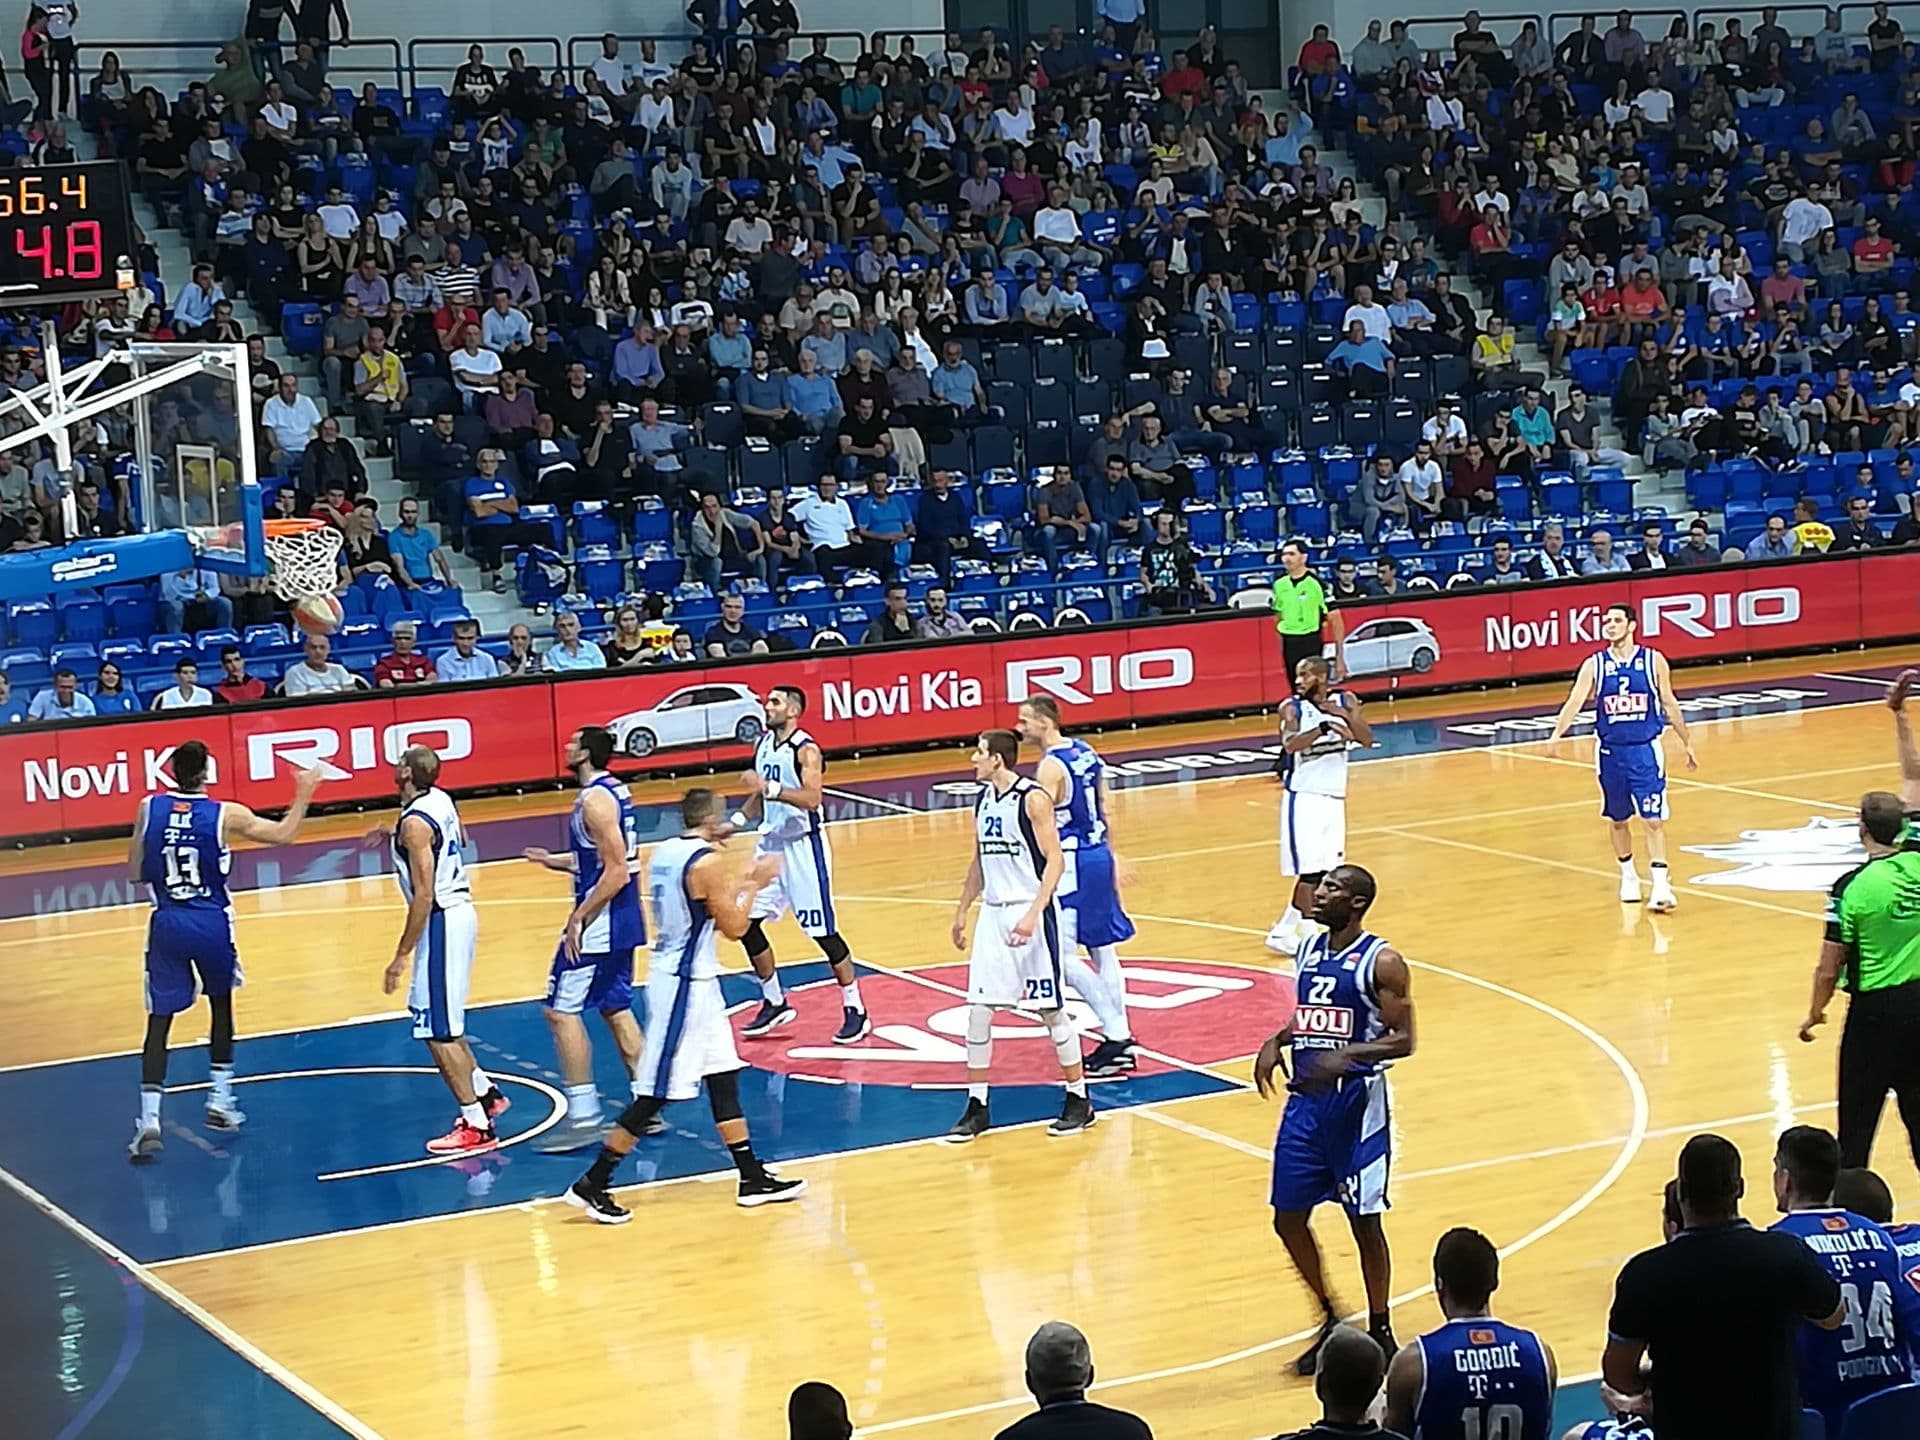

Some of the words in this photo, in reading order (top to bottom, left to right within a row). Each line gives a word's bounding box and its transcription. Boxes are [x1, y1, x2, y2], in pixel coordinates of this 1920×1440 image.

[16, 220, 102, 279] 4.8
[1641, 587, 1801, 638] RIO
[1485, 611, 1559, 652] Novi
[1006, 648, 1195, 705] RIO
[1619, 676, 1631, 696] 2
[822, 675, 910, 721] Novi
[921, 670, 983, 711] Kia
[248, 717, 473, 781] RIO
[23, 751, 130, 803] Novi
[763, 764, 781, 782] 20
[984, 816, 1003, 838] 29
[161, 845, 201, 886] 13
[798, 909, 823, 929] 20
[1025, 978, 1054, 1000] 29
[1307, 975, 1338, 1005] 22
[1296, 1008, 1350, 1034] VOLI
[1453, 1340, 1522, 1373] GORDIĆ
